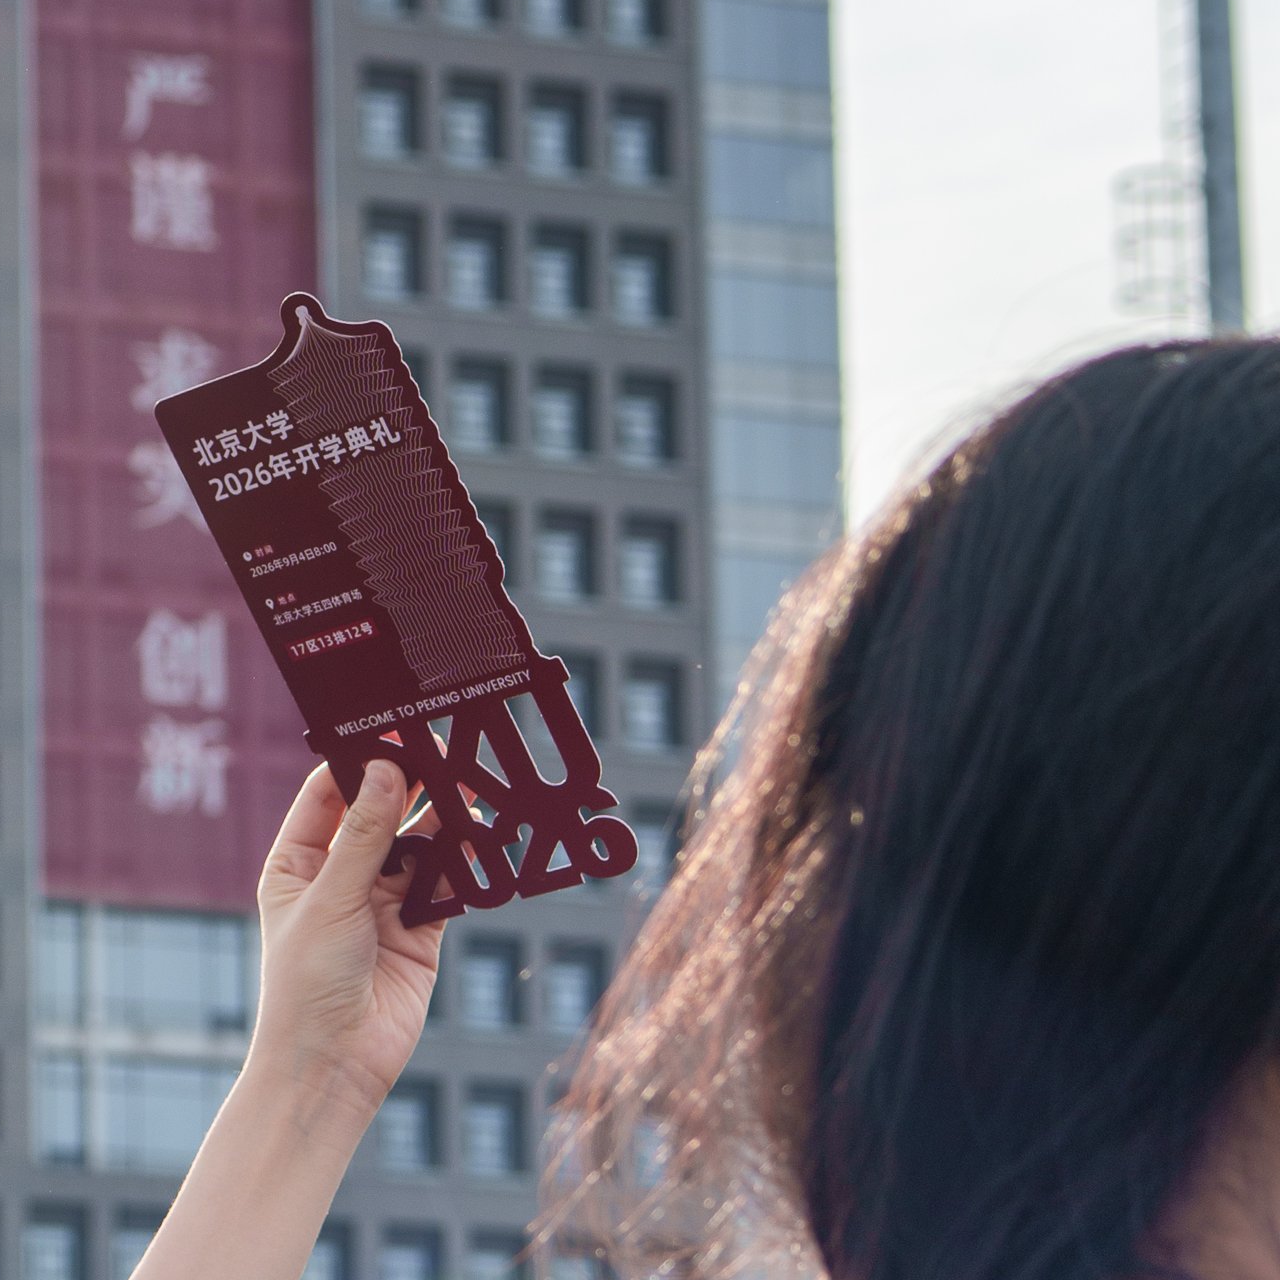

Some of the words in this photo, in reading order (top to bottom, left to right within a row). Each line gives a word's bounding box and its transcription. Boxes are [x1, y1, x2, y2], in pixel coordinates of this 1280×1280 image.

[192, 409, 294, 467] 北京大学
[208, 417, 401, 502] 2026年开学典礼
[249, 541, 338, 578] 2026年9月4日8:00
[254, 544, 274, 557] 时间
[273, 588, 363, 626] 北京大学五四体育场
[290, 621, 373, 657] 17区13排12号
[334, 709, 397, 737] WELCOME
[396, 704, 415, 719] TO
[417, 690, 461, 714] PEKING
[462, 669, 532, 700] UNIVERSITY
[382, 782, 639, 930] 2026
